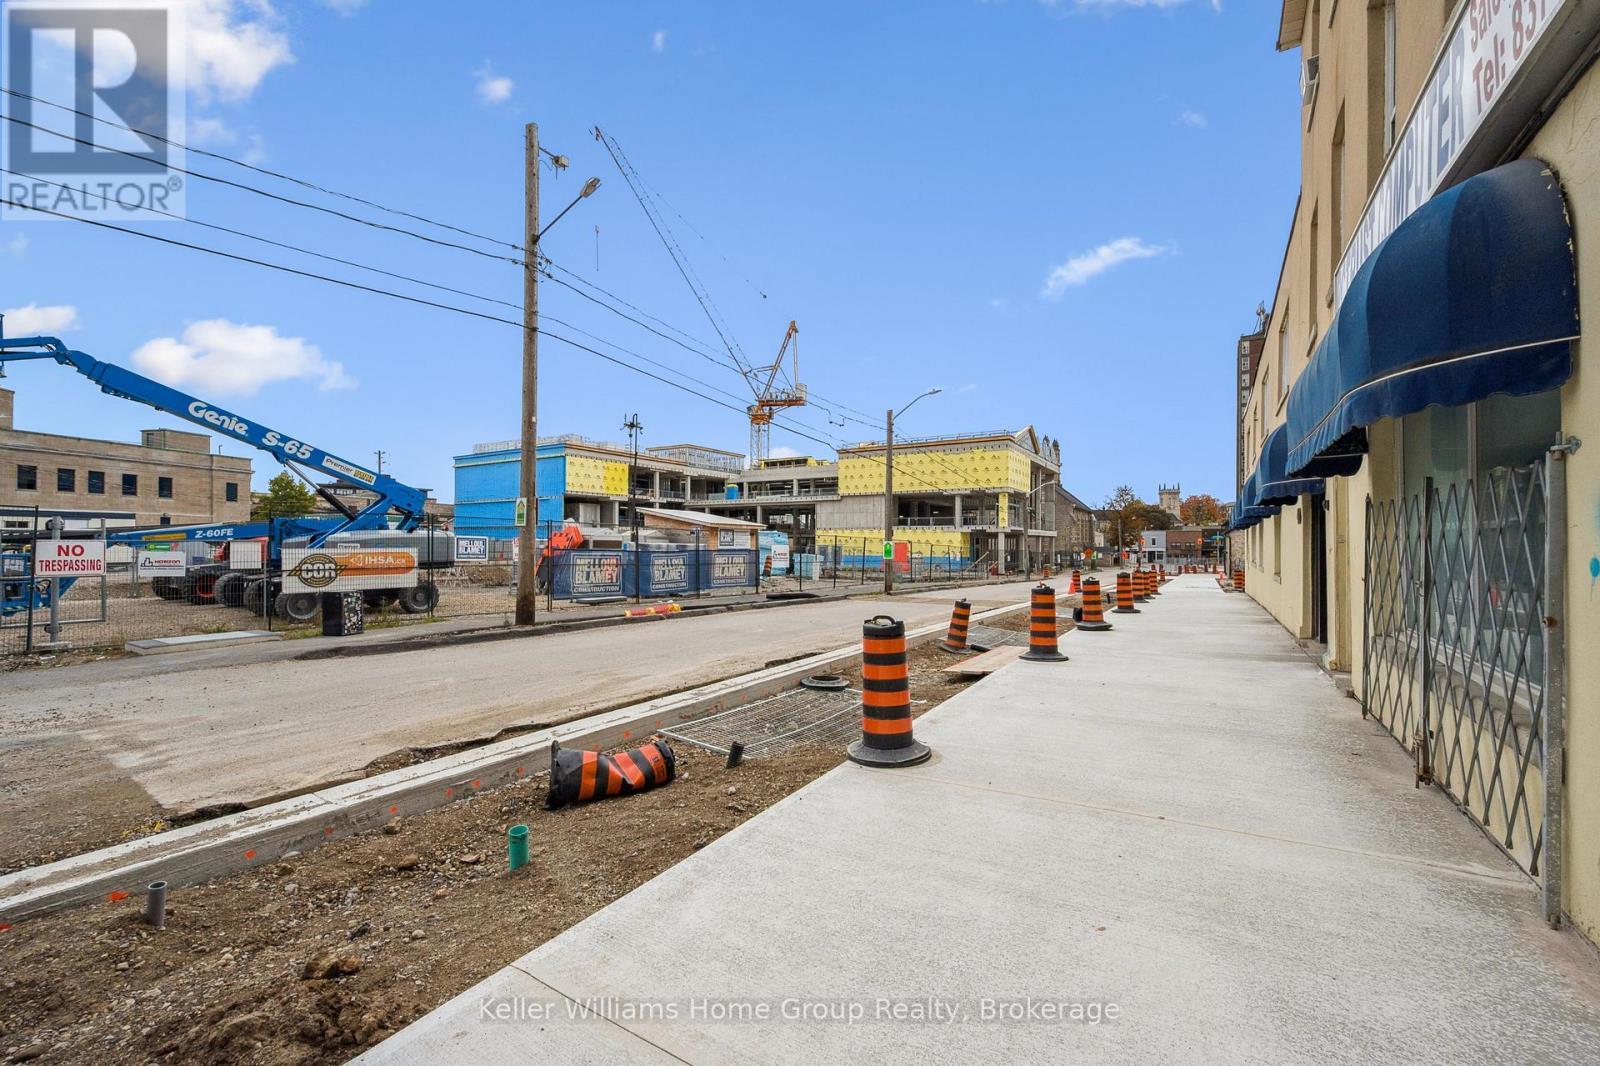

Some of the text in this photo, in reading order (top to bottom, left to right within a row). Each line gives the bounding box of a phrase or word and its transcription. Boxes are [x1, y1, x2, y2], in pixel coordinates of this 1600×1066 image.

[1472, 33, 1506, 114] Tel:
[188, 401, 314, 460] Genie S-65
[326, 457, 354, 474] Premier
[194, 528, 234, 539] Z-60FE
[57, 544, 85, 557] NO
[39, 559, 102, 572] TRESPASSING
[301, 563, 336, 579] COR
[575, 570, 618, 584] BLAMEY
[654, 568, 686, 581] BLAMEY
